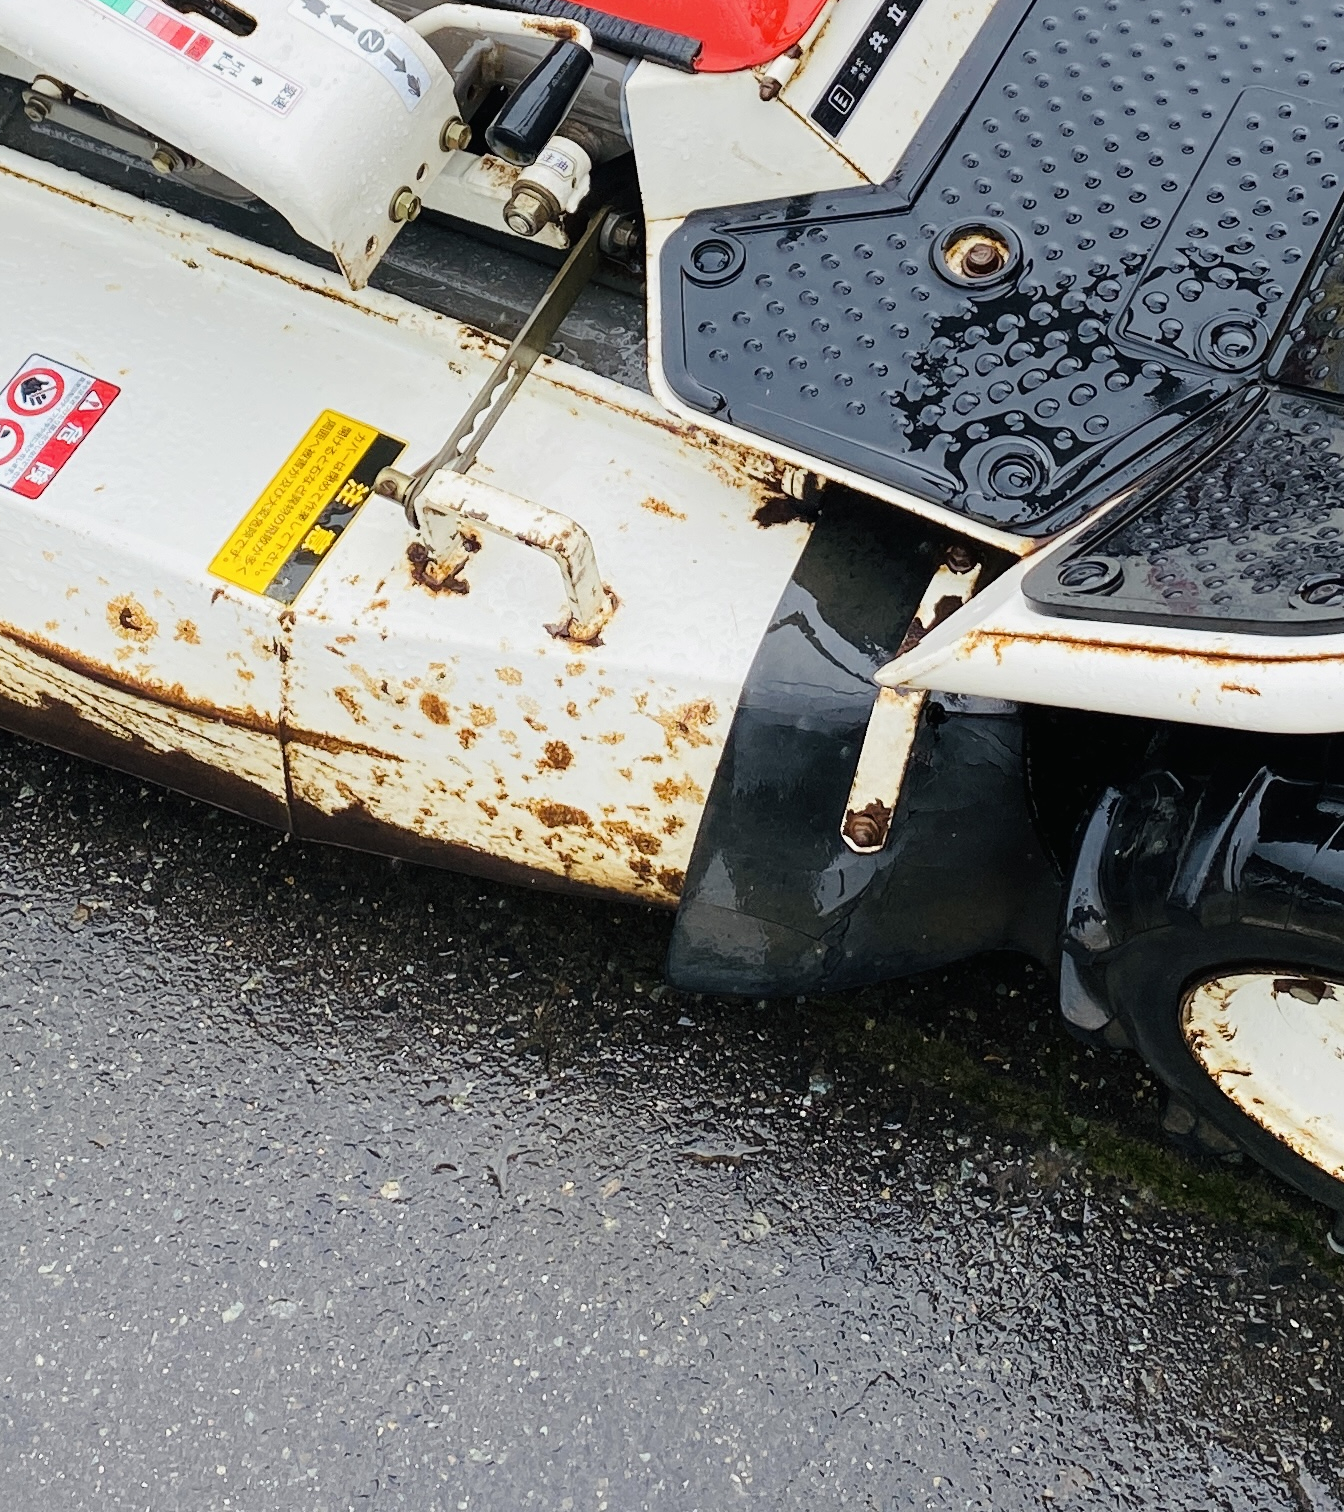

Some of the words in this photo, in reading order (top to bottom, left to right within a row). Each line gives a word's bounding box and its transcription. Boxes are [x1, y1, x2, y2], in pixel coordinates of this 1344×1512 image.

[361, 32, 383, 51] N
[865, 0, 908, 55] 共立
[269, 81, 299, 113] 変速
[23, 420, 86, 486] 危険
[253, 431, 368, 579] カバーは閉めて作業して下さい。
[297, 477, 371, 557] 注意
